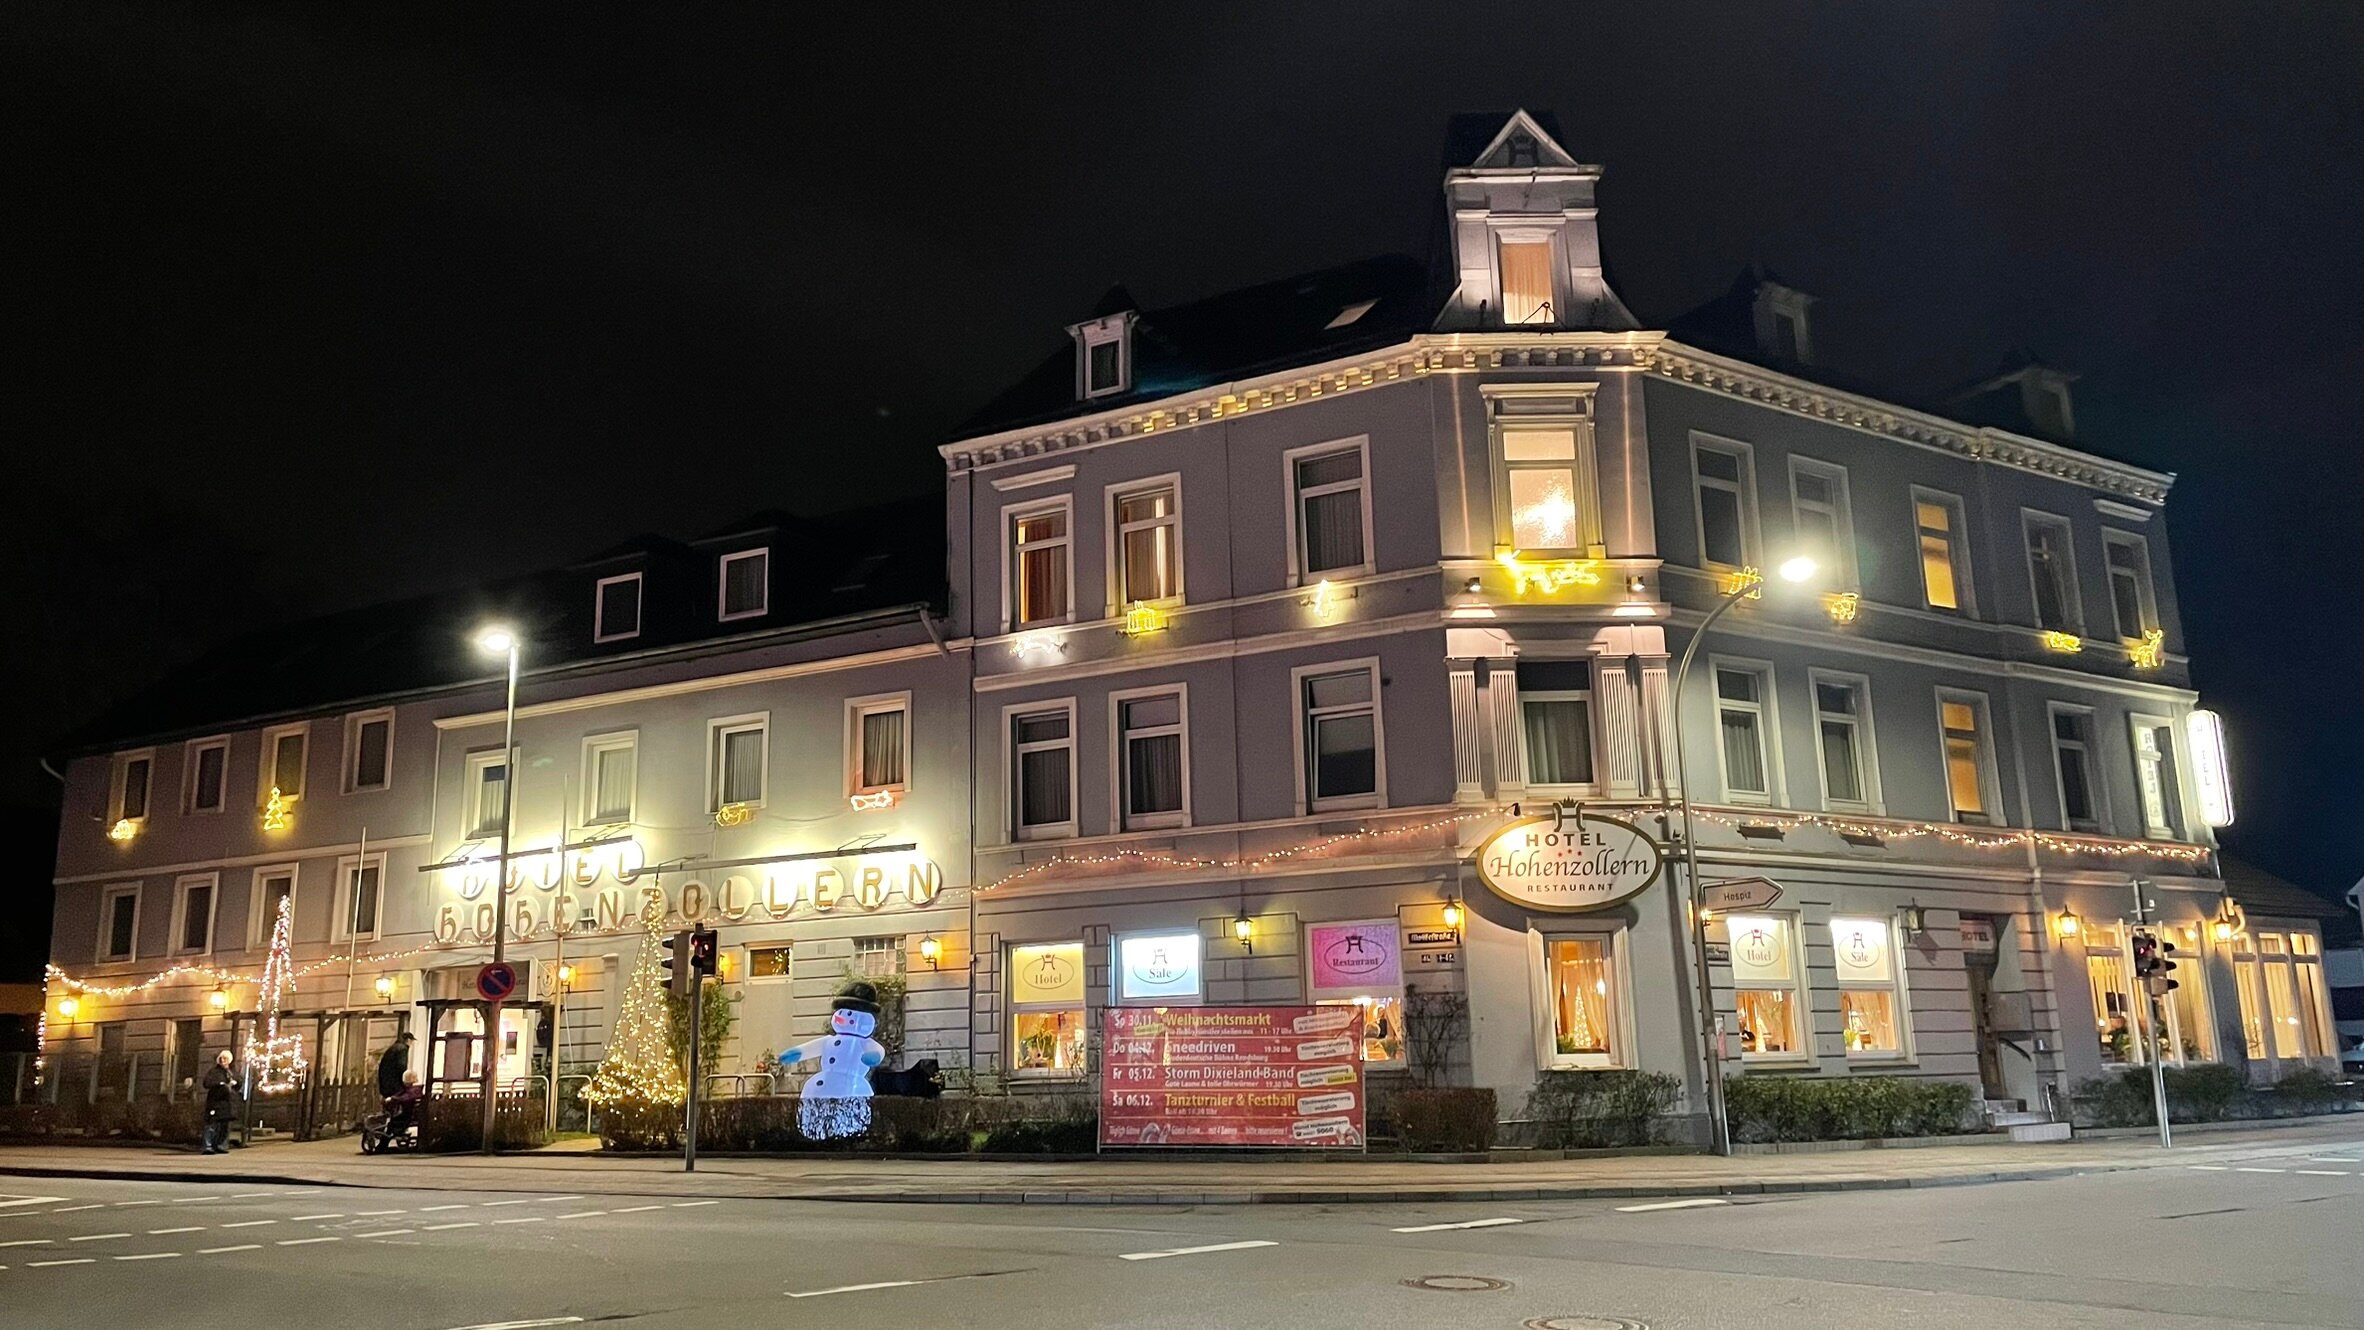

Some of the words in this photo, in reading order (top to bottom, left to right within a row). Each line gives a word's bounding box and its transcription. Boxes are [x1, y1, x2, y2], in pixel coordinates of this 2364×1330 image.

[1525, 833, 1607, 847] HOTEL
[1489, 848, 1650, 878] Hohenzollern
[1527, 882, 1614, 893] RESTAURANT
[1723, 889, 1752, 902] Hospiz
[1332, 957, 1379, 967] Restaurant
[1747, 948, 1772, 962] Hotel
[1034, 973, 1063, 986] Hotel
[1166, 1012, 1271, 1026] Weihnachtsmarkt
[1112, 1067, 1122, 1080] Fr
[1128, 1067, 1156, 1081] 05.12.
[1164, 1066, 1200, 1080] Storm
[1112, 1094, 1124, 1106] Sa
[1126, 1094, 1154, 1106] 06.12.
[1164, 1093, 1234, 1107] Tanzturnier
[1235, 1093, 1245, 1107] &
[1247, 1092, 1295, 1107] Festball
